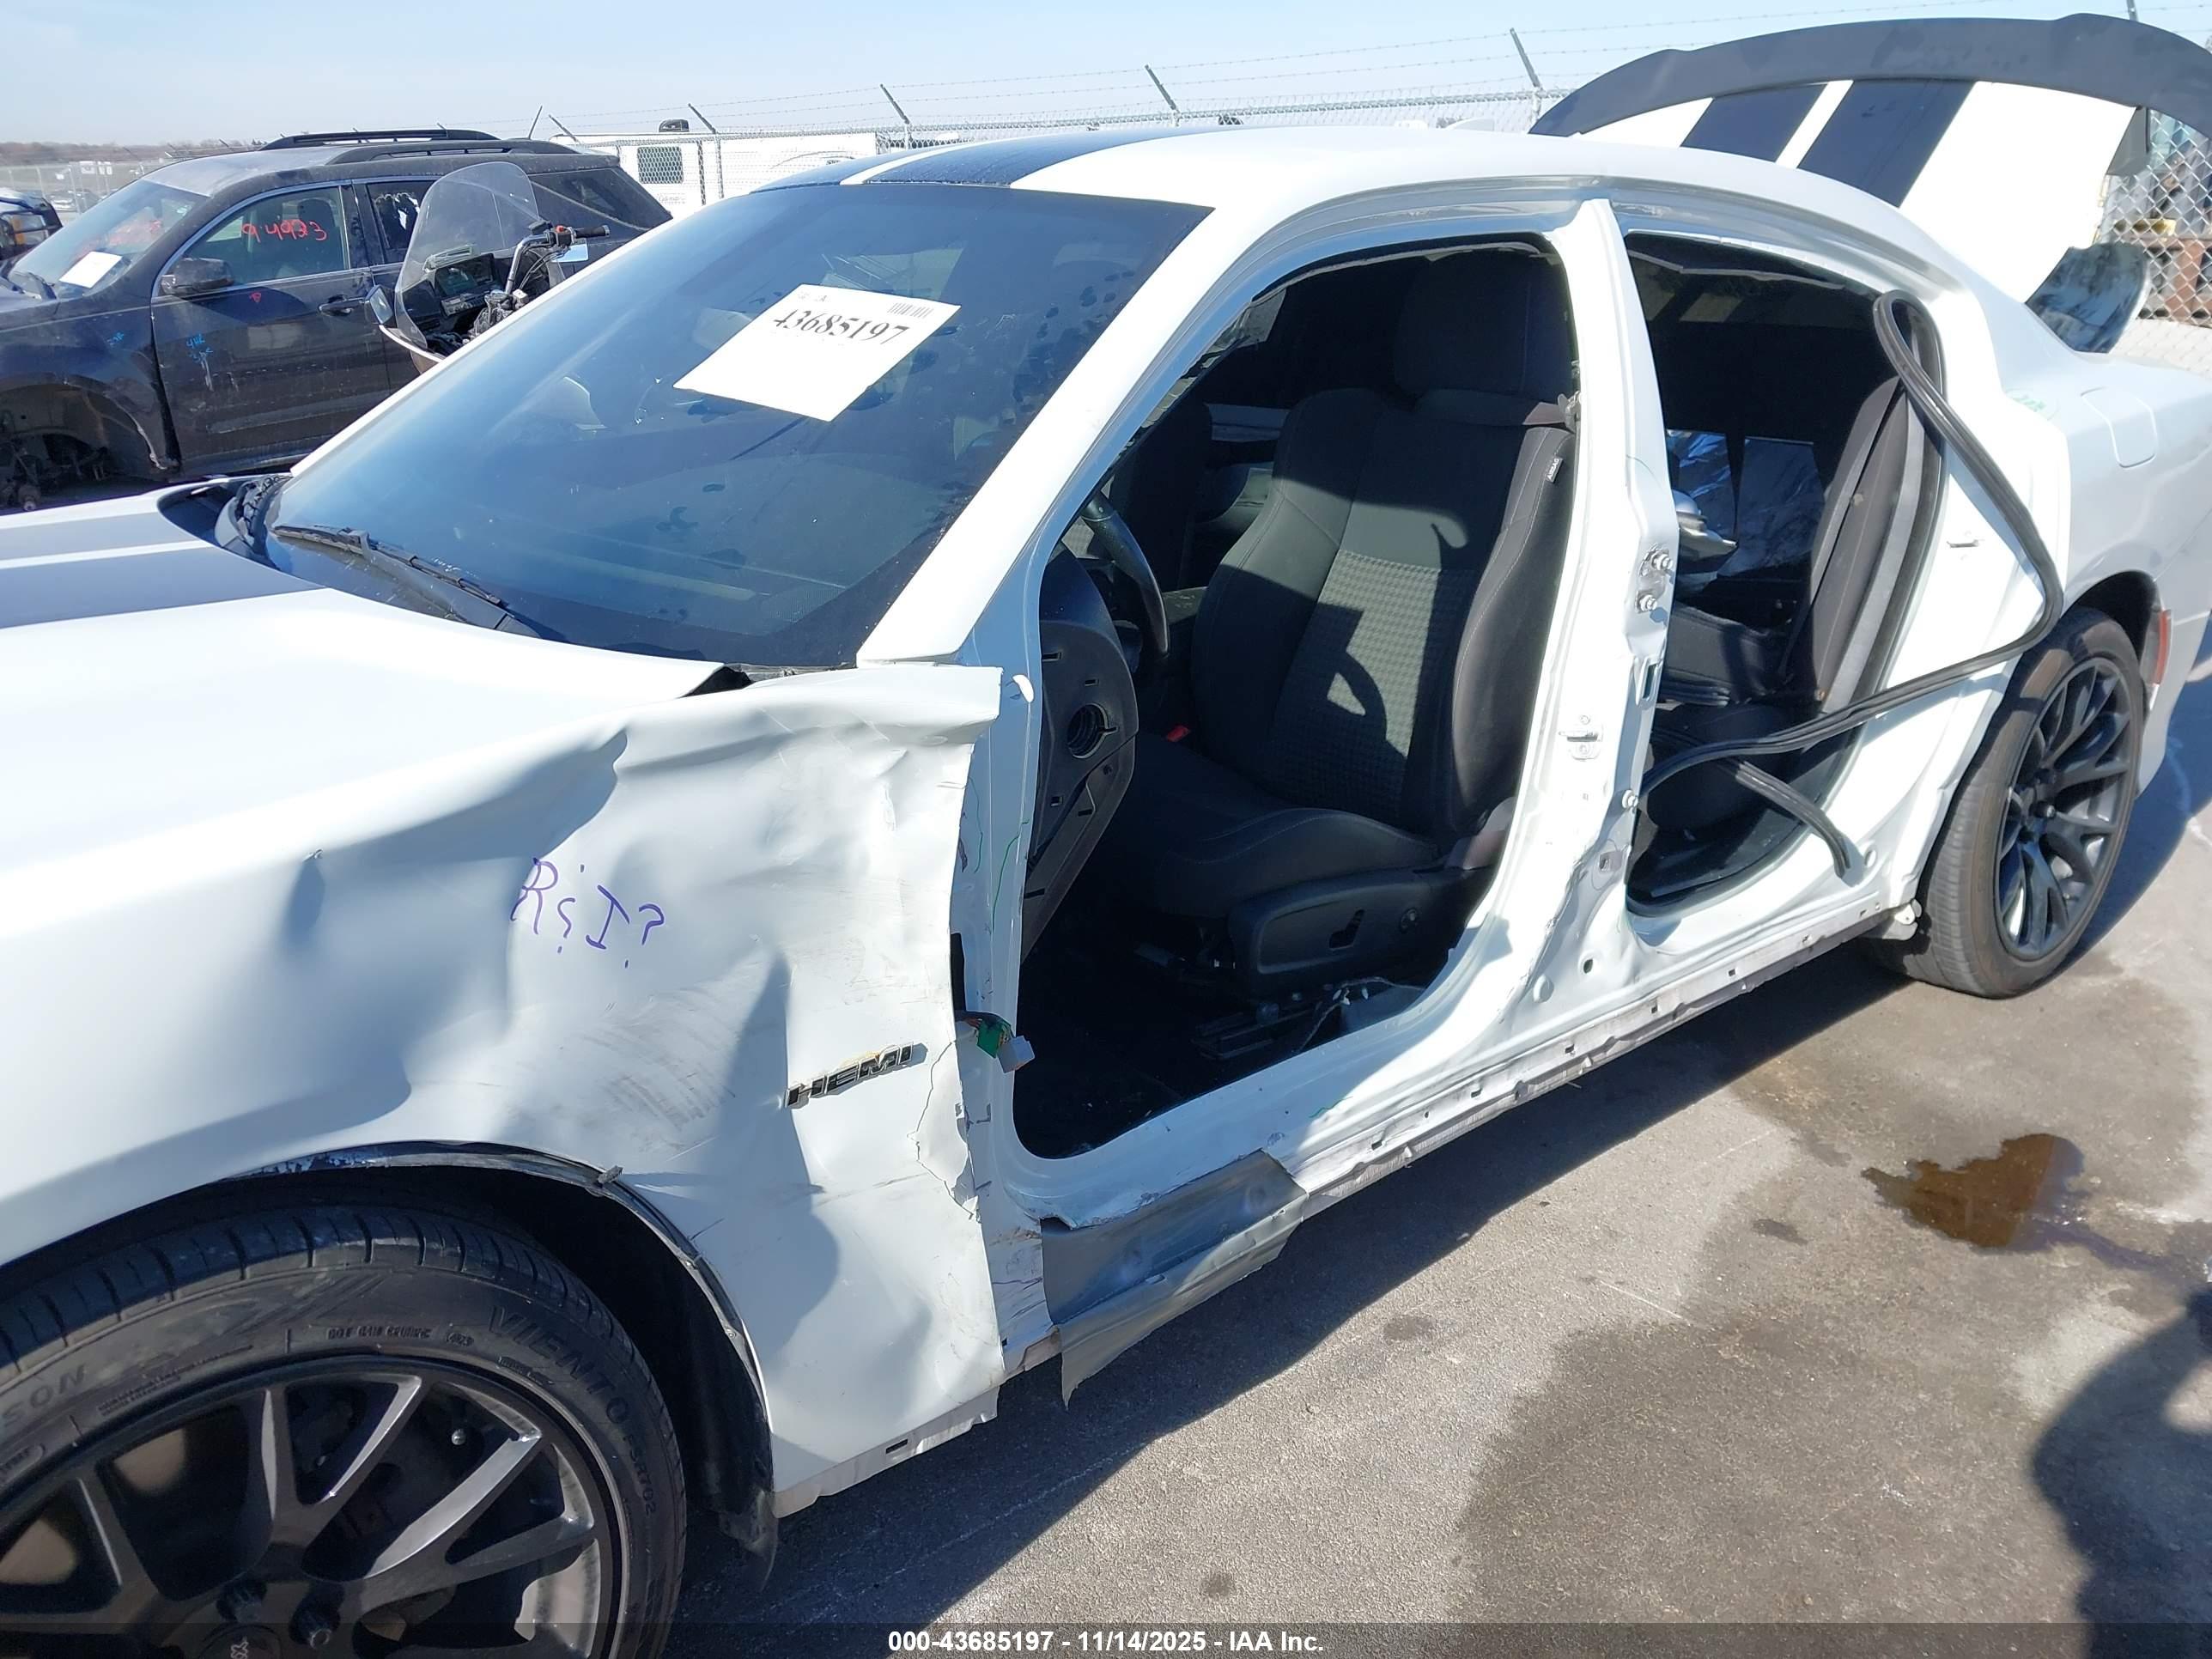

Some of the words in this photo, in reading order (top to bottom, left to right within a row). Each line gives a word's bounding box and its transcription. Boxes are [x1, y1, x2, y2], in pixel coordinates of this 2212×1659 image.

[774, 309, 910, 344] 43685197
[785, 1042, 915, 1109] HEMI
[488, 1304, 630, 1425] VIENTO
